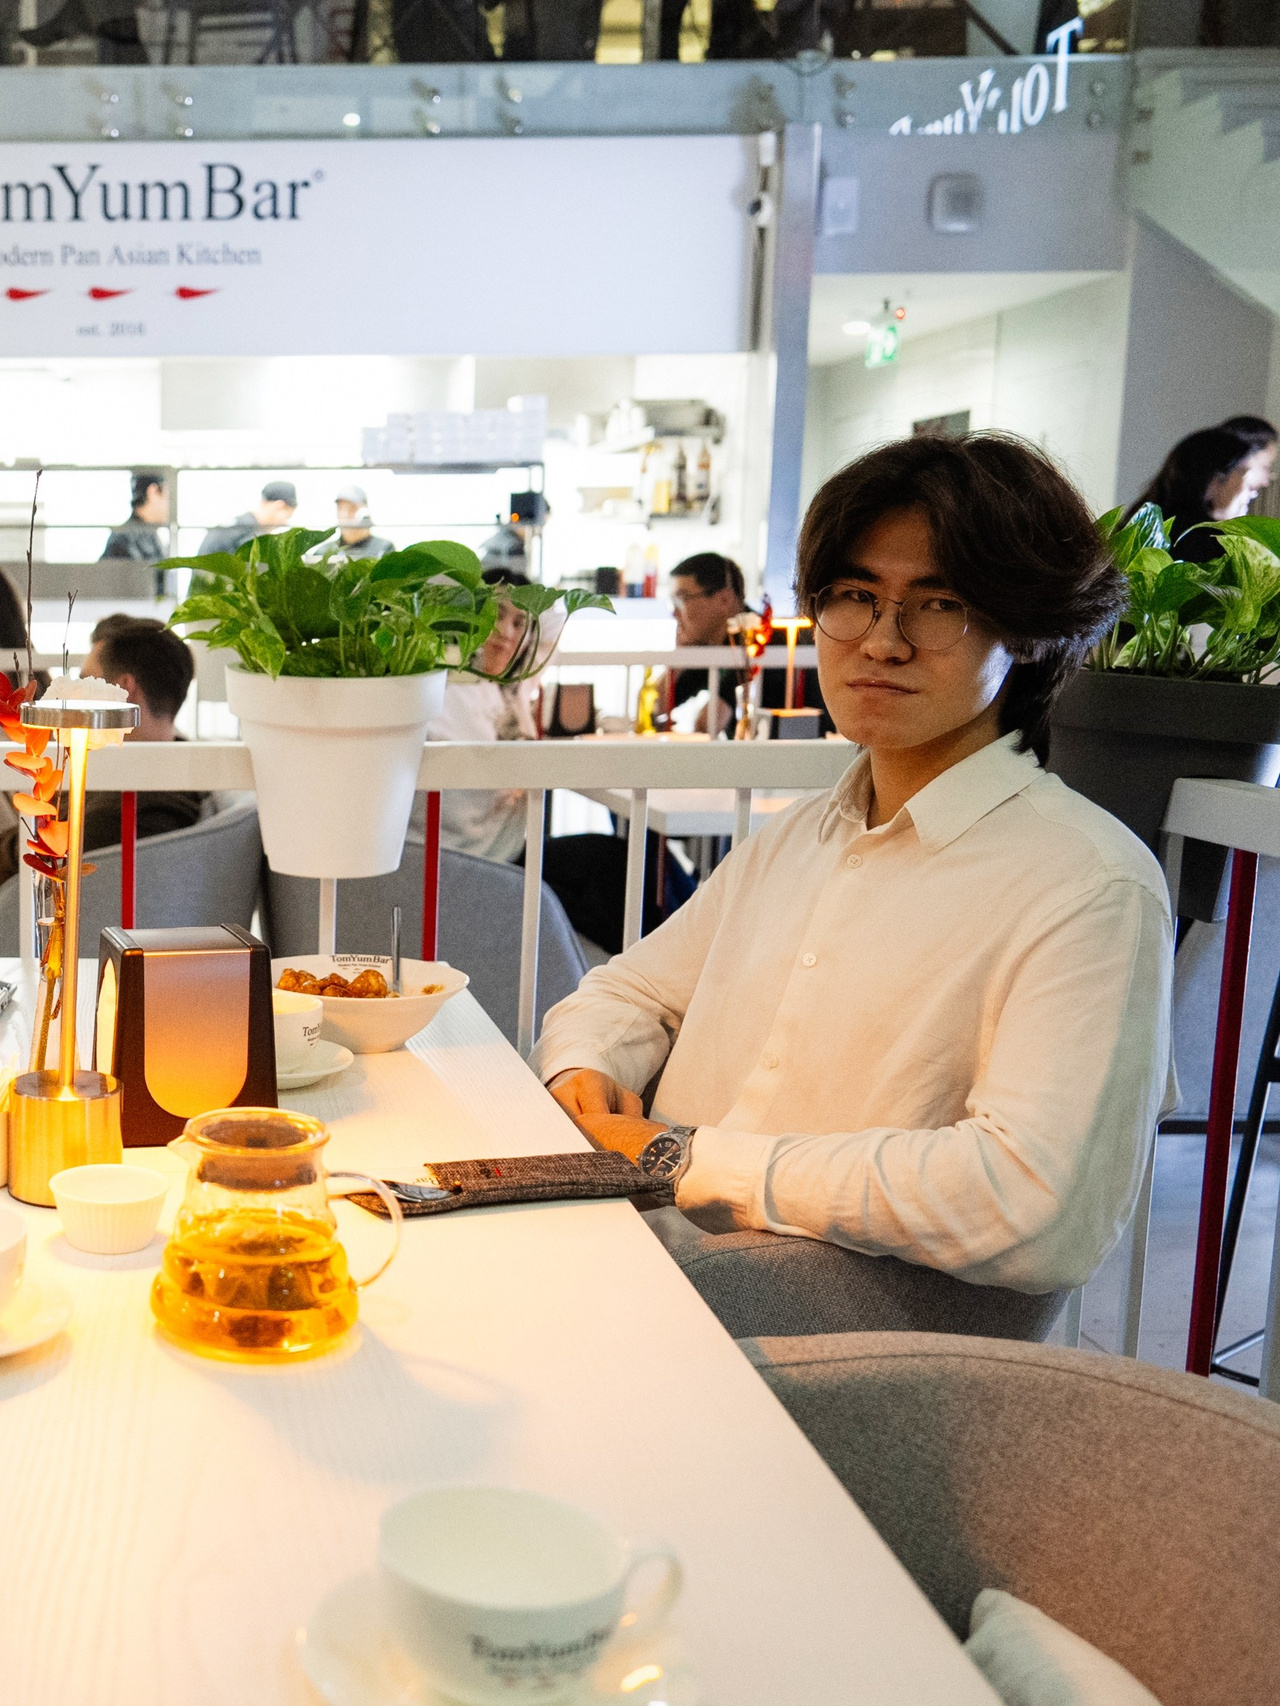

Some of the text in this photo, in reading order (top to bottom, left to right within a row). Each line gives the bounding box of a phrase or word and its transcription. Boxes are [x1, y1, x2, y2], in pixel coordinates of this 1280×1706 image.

[60, 243, 101, 266] Pan
[106, 243, 170, 266] Asian
[175, 243, 262, 266] Kitchen
